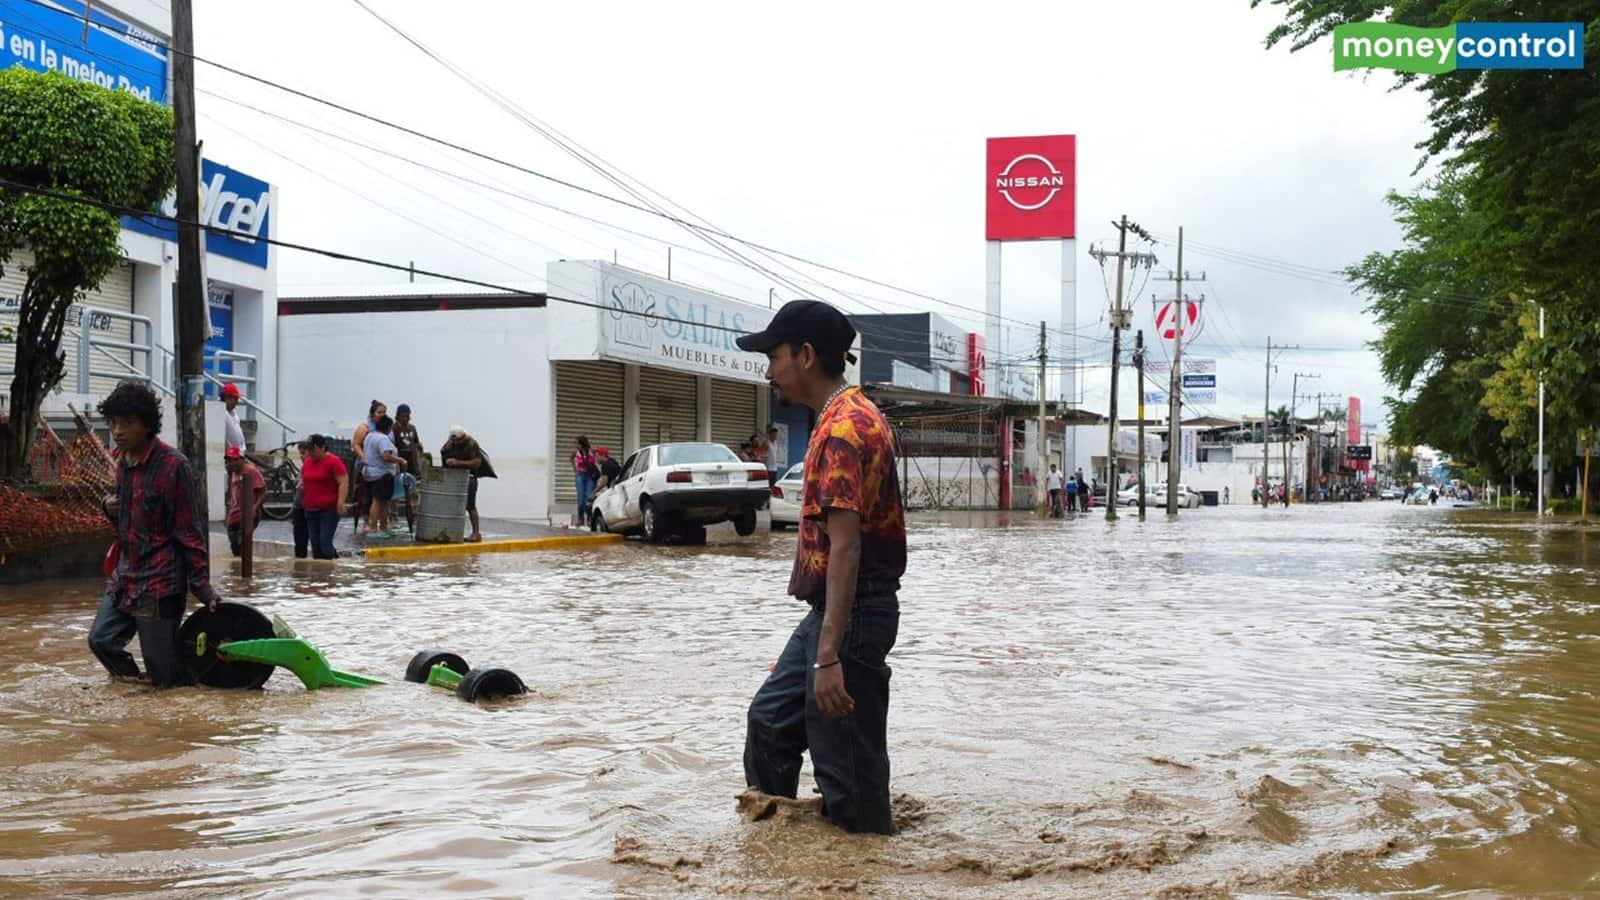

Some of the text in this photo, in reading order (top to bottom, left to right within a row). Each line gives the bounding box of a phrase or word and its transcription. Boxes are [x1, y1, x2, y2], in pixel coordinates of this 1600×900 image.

[10, 34, 36, 62] en
[40, 40, 57, 68] la
[996, 176, 1064, 188] NISSAN
[662, 295, 745, 353] SALAS
[661, 344, 727, 367] MUEBLES
[731, 361, 740, 370] &
